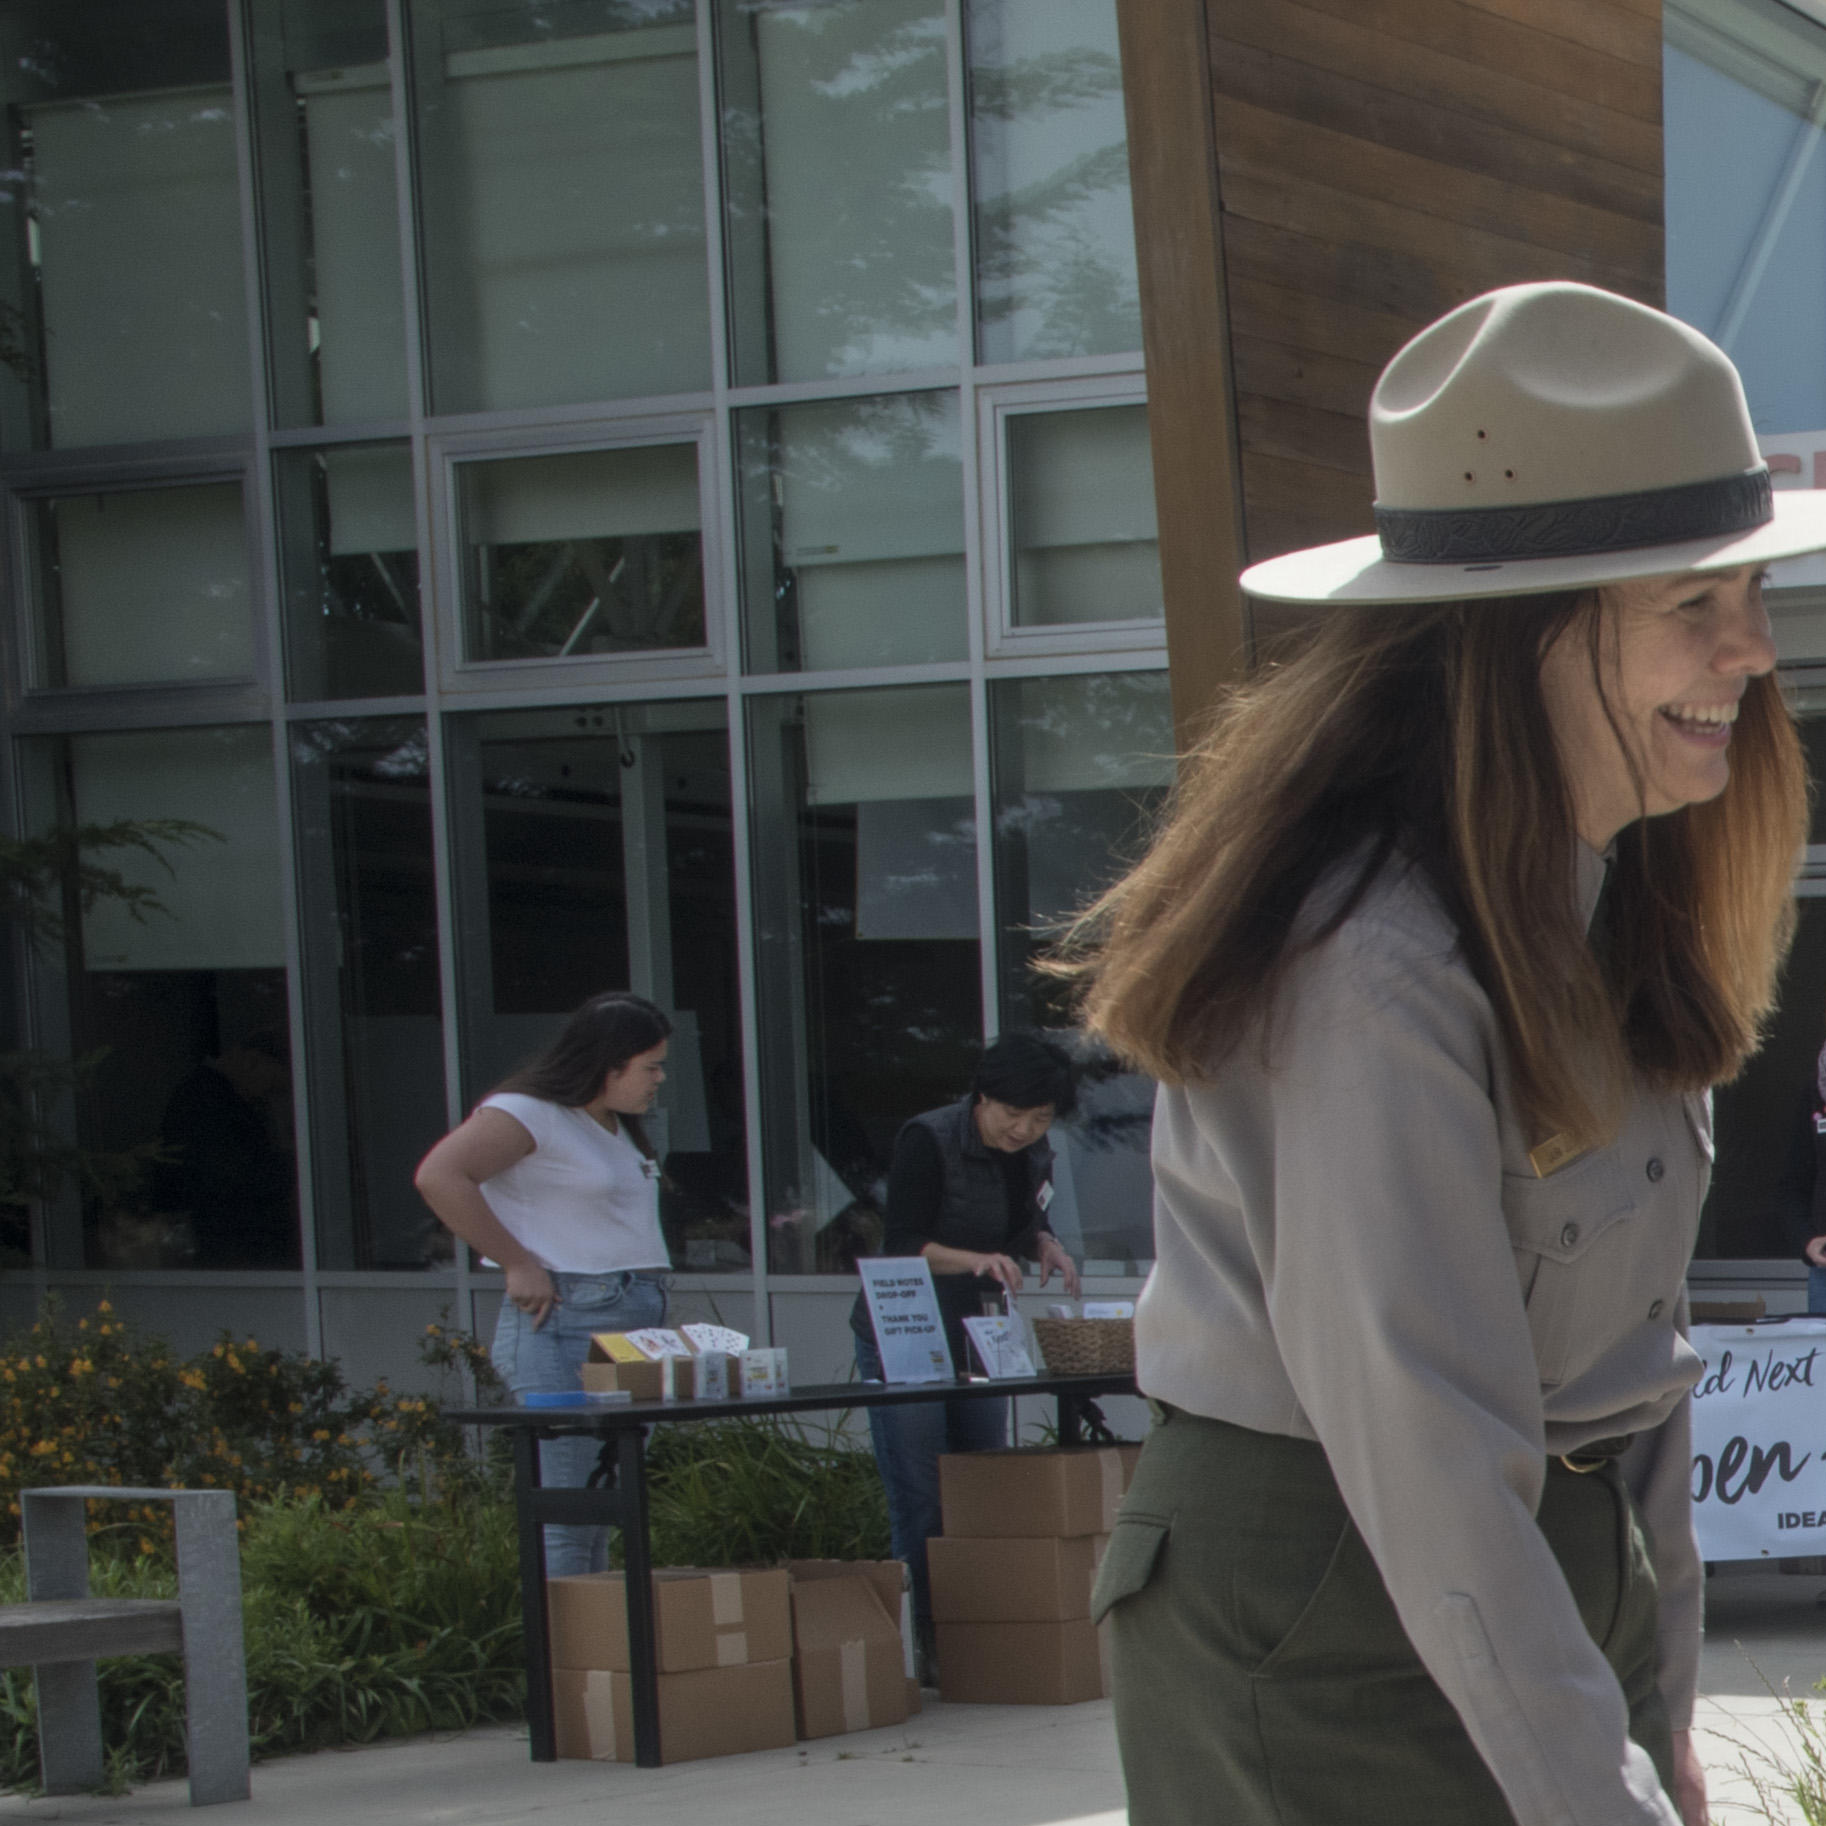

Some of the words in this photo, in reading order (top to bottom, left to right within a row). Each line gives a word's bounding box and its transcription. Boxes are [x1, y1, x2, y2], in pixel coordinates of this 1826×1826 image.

[872, 1279, 895, 1287] FIELD
[897, 1278, 924, 1286] NOTES
[882, 1314, 909, 1322] THANK
[912, 1313, 928, 1321] YOU
[1743, 1347, 1823, 1398] Next
[1692, 1436, 1811, 1504] pen
